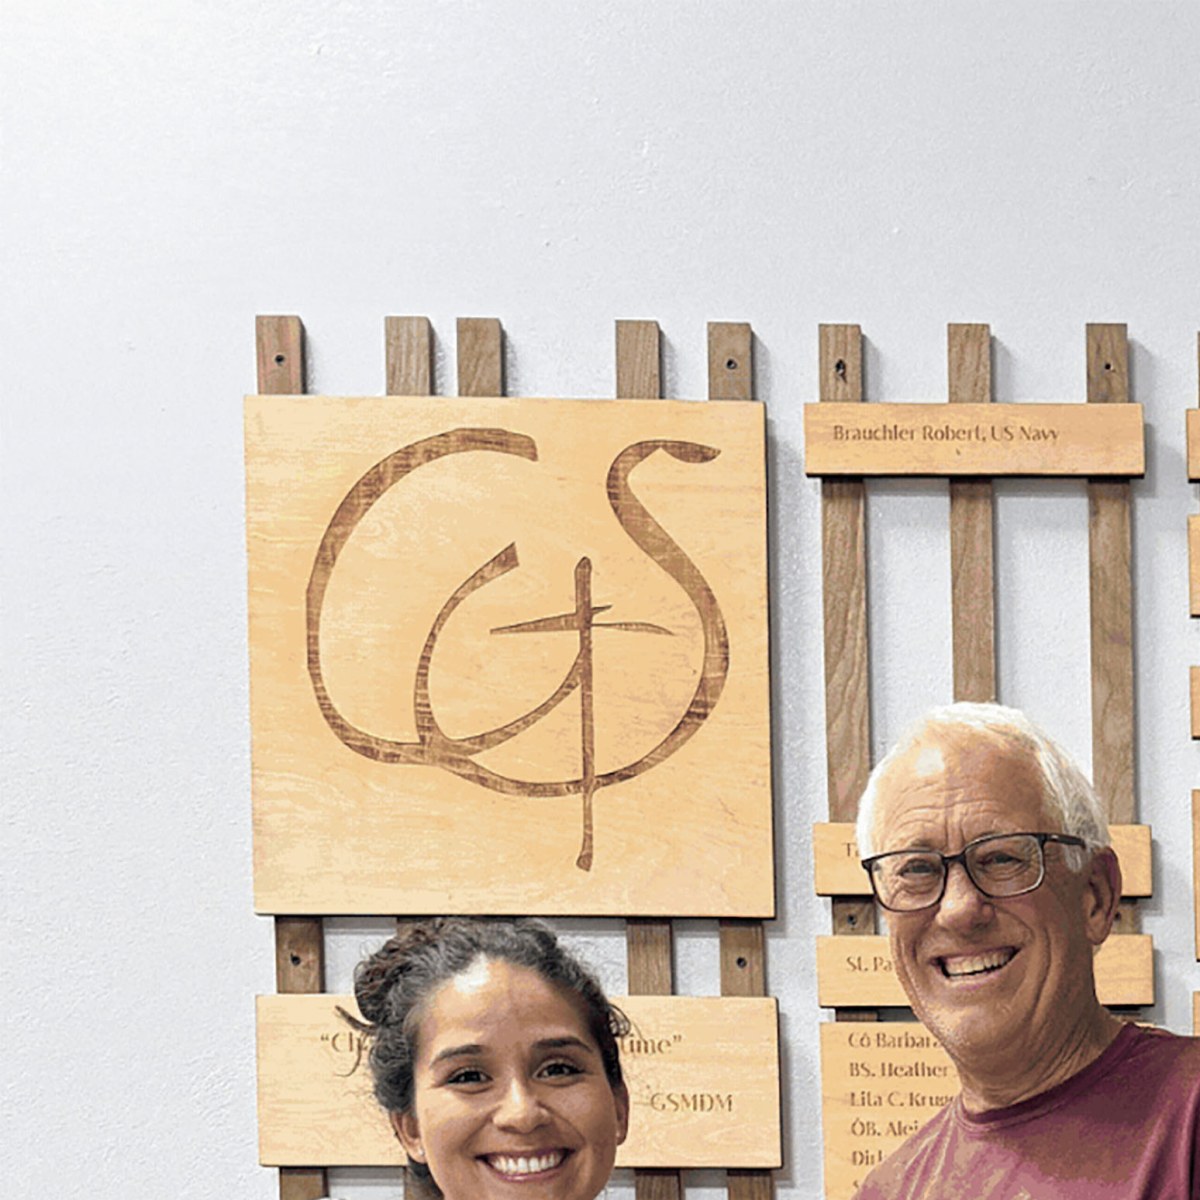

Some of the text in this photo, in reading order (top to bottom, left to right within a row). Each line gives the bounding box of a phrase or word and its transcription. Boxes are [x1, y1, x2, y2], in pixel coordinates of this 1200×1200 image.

[833, 424, 1061, 443] Brauchler Robert, US Navy
[846, 956, 868, 971] St.
[850, 1061, 948, 1077] BS. Heather
[887, 1091, 904, 1107] C.
